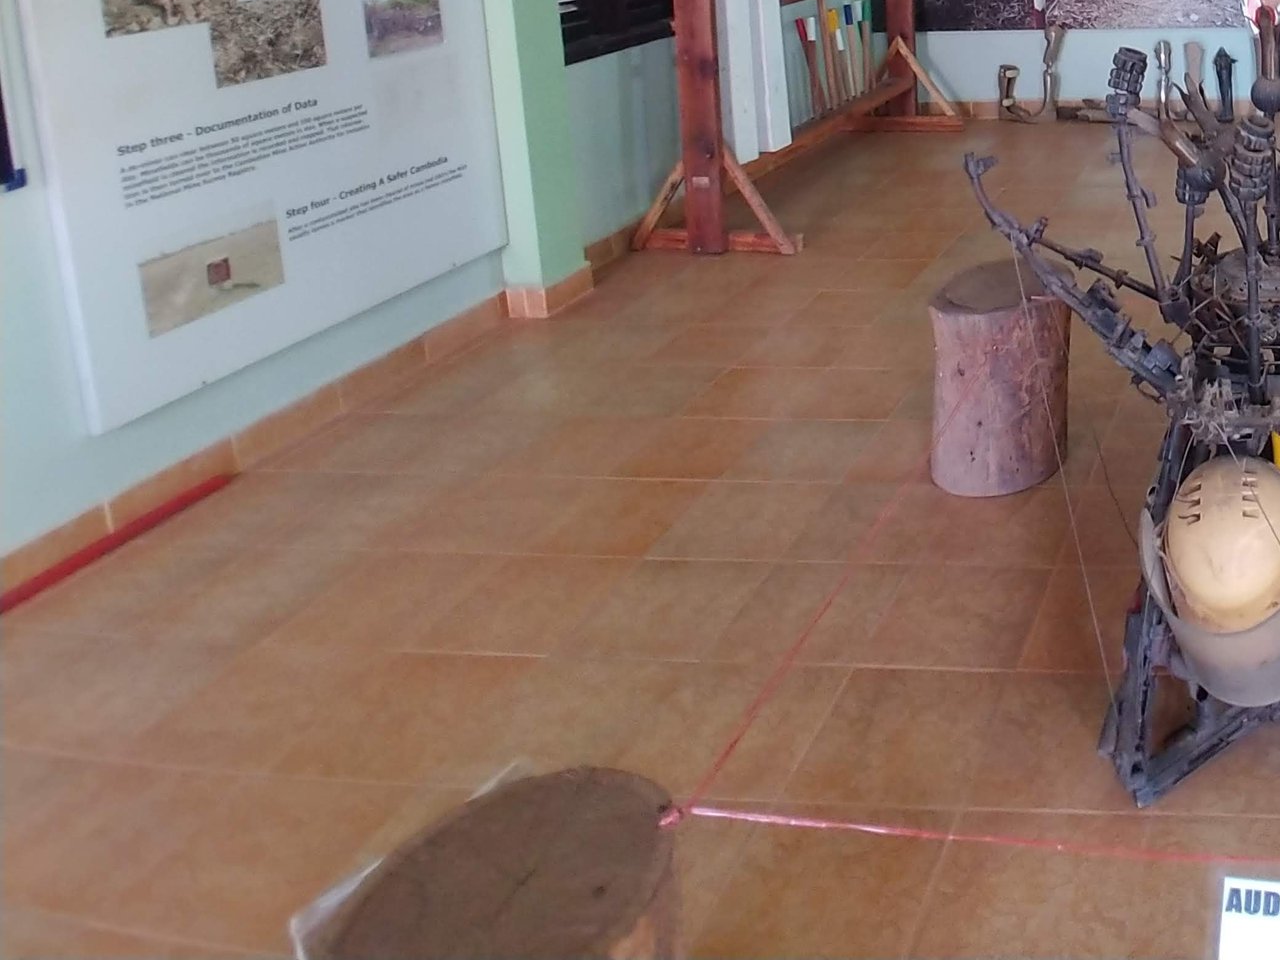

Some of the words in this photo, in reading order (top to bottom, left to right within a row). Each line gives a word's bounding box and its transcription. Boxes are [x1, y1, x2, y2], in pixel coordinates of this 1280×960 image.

[117, 140, 147, 156] Step
[150, 132, 184, 148] three
[194, 107, 279, 137] Documentation
[282, 103, 292, 114] of
[294, 98, 318, 111] Data
[286, 205, 308, 219] Step
[311, 196, 330, 210] four
[339, 181, 377, 200] Creating
[379, 178, 385, 186] A
[387, 170, 408, 183] Safer
[410, 156, 448, 174] Cambodia
